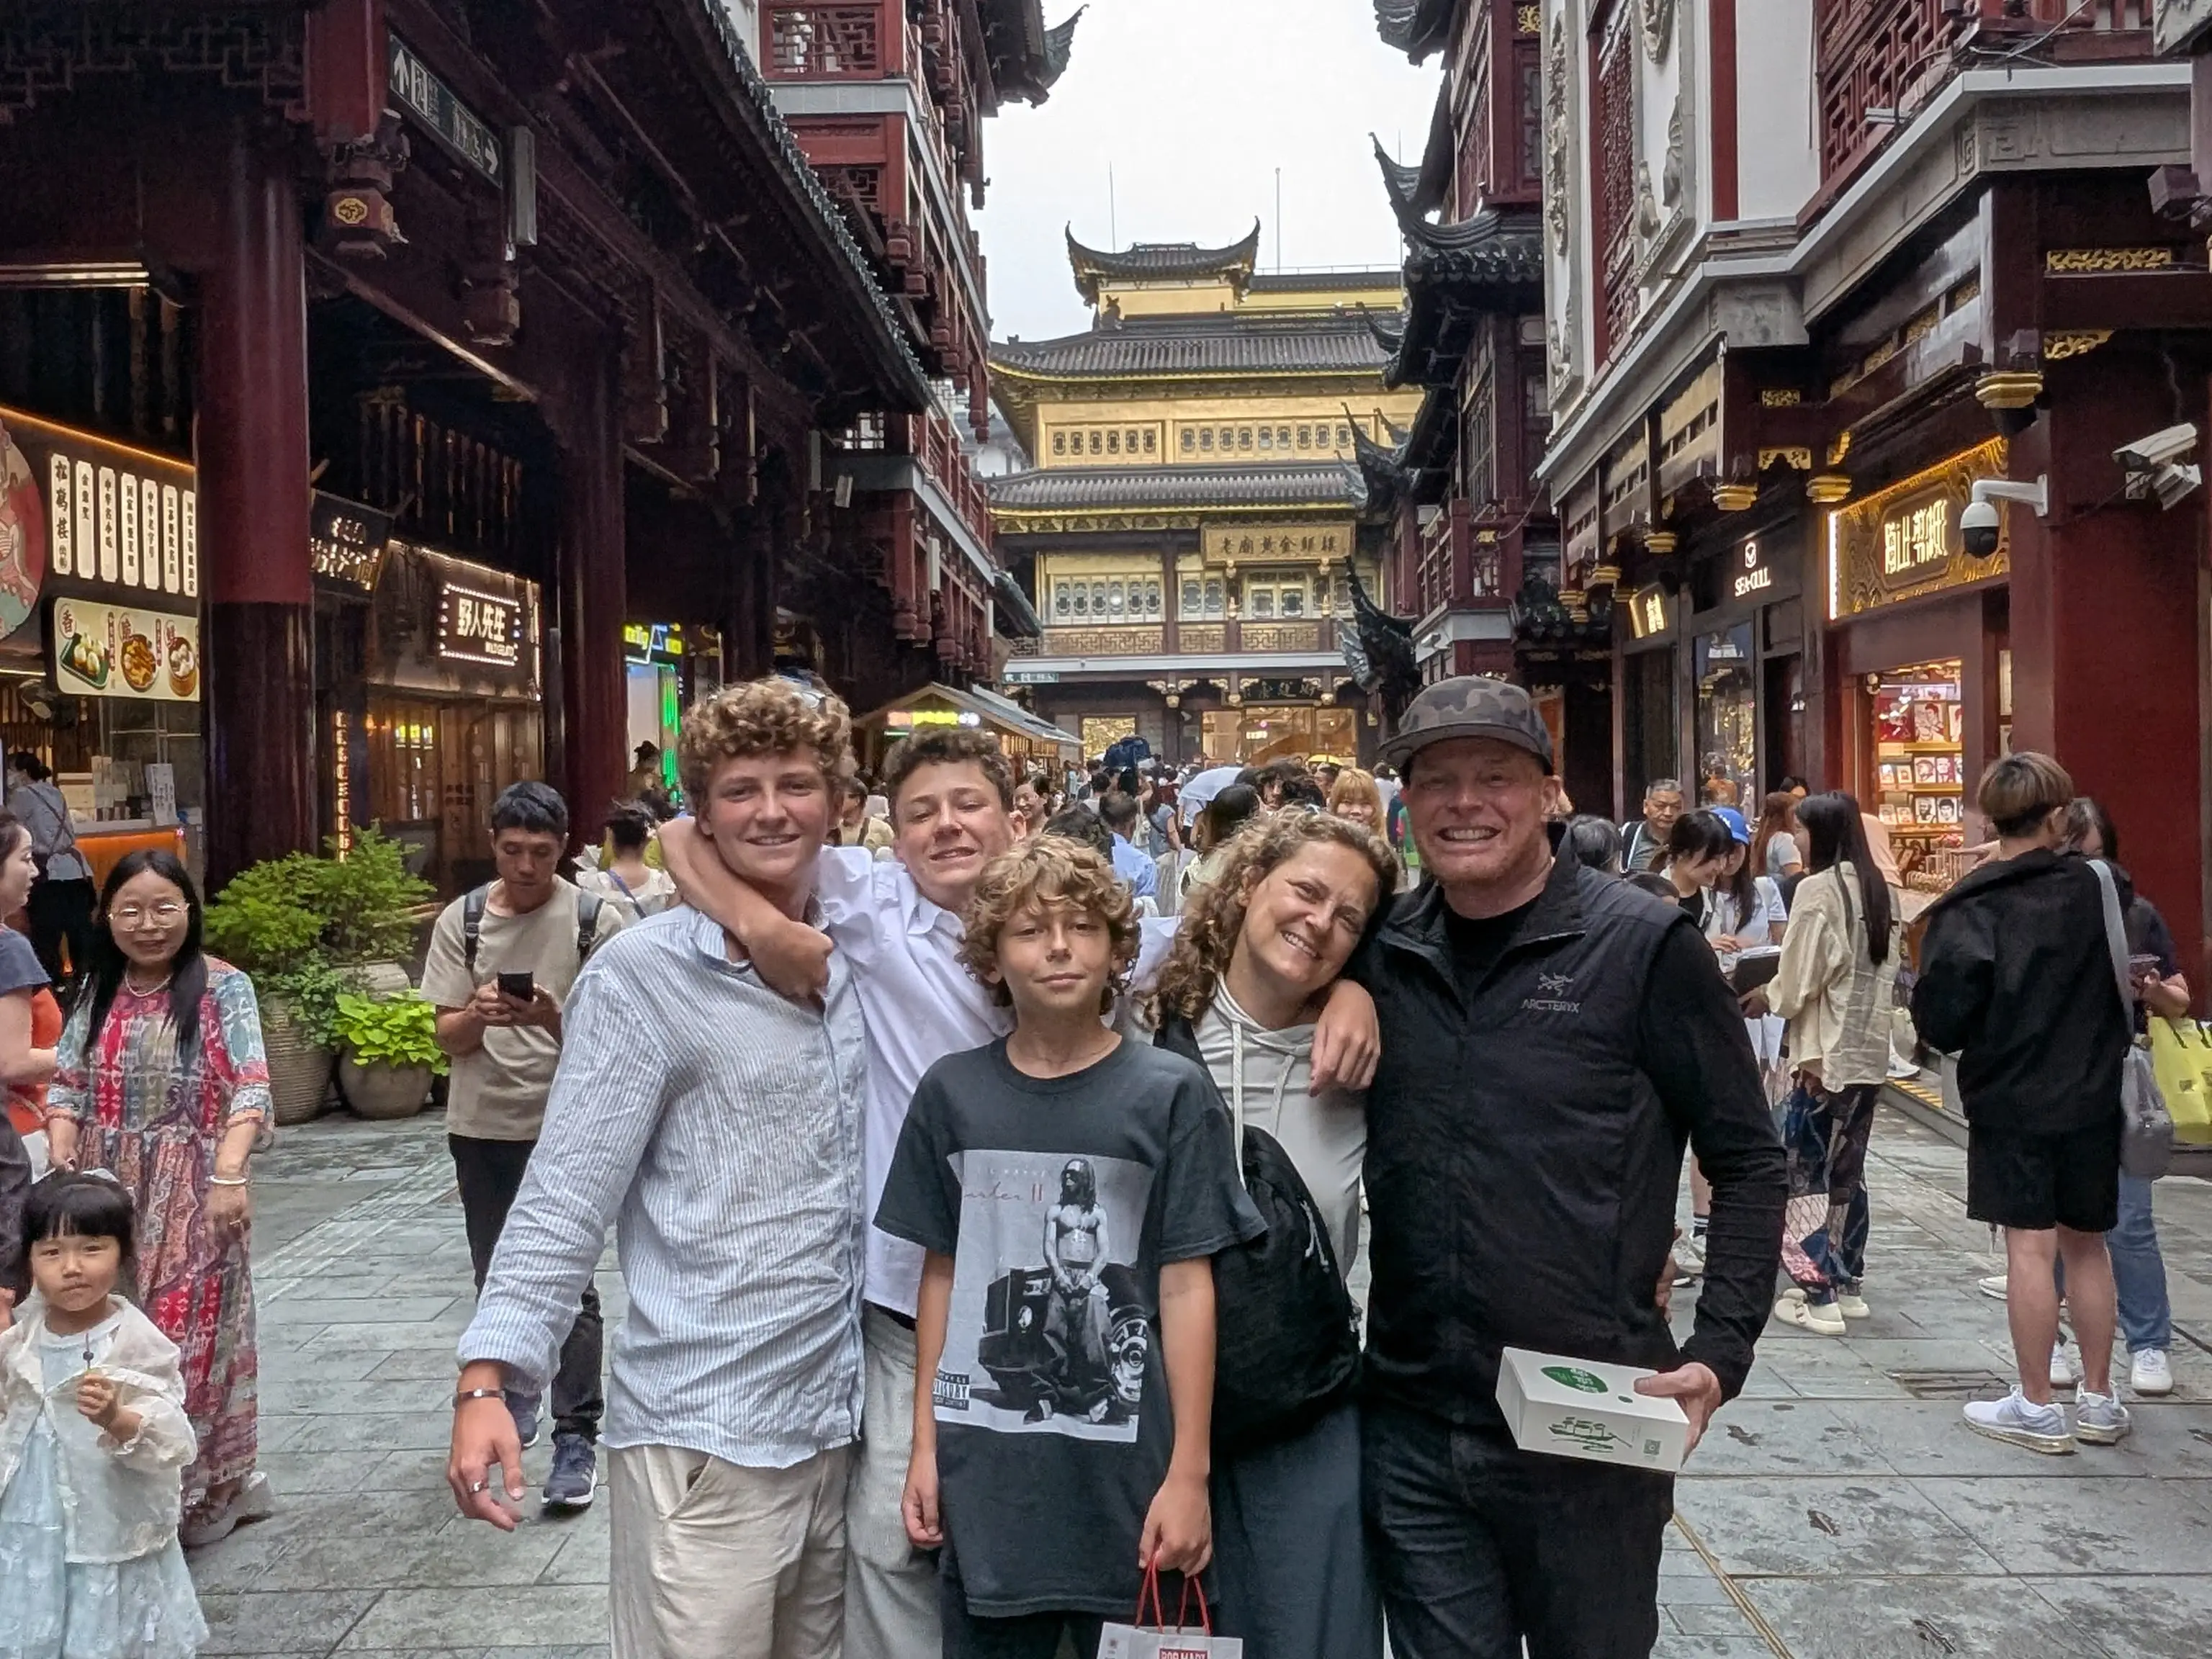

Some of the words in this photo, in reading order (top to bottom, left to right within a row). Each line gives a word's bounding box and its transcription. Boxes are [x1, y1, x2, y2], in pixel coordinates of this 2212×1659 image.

[61, 609, 73, 634] 香
[457, 597, 506, 642] 野人先生
